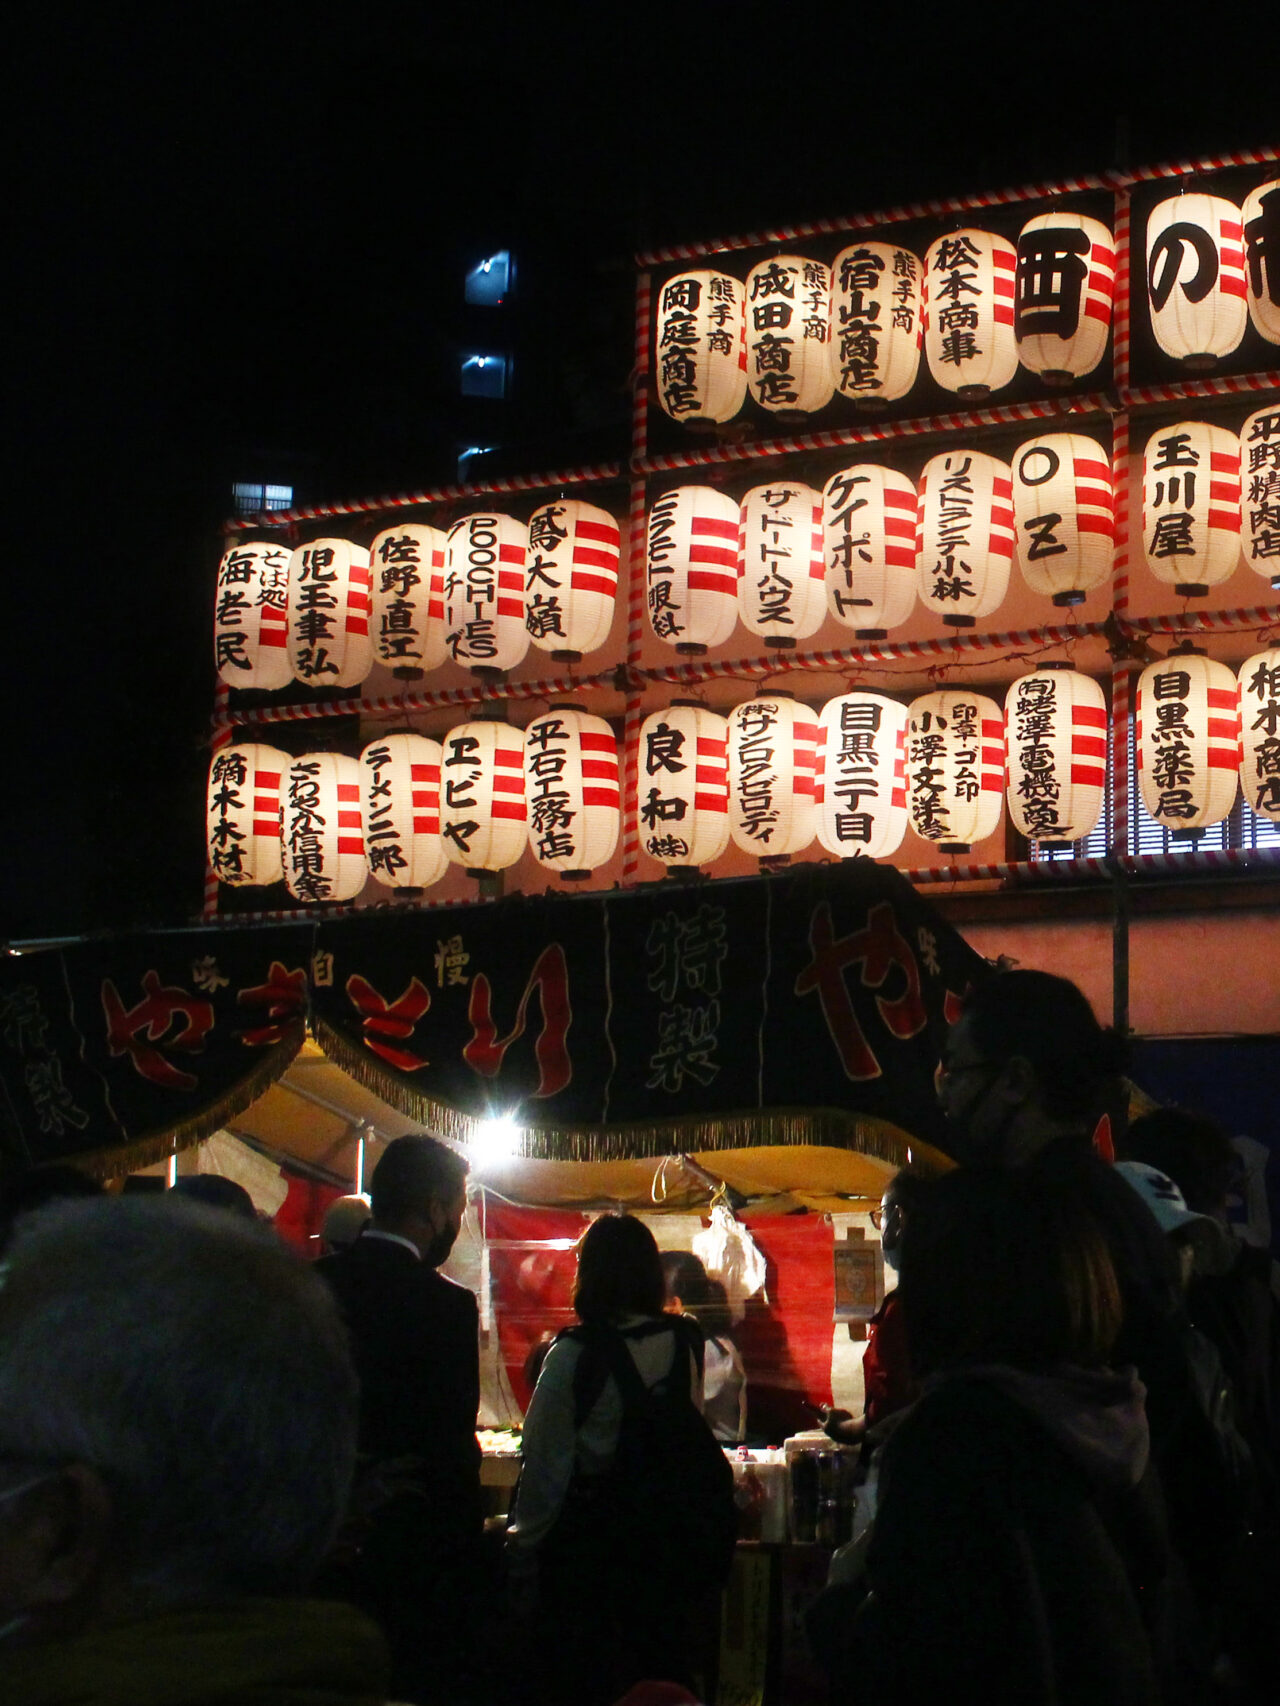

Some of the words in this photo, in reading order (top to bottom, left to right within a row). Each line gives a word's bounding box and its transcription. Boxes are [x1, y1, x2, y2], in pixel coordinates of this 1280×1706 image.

[659, 279, 702, 416] 岡庭商店
[706, 277, 737, 355] 熊手商
[750, 263, 800, 404] 成田商店
[801, 262, 828, 344] 熊手商
[838, 248, 885, 391] 宿山商店
[891, 250, 917, 334] 熊手商
[932, 237, 984, 367] 松本商事
[827, 475, 873, 617] ケイポート
[931, 457, 977, 602] リストランテ小林
[1149, 434, 1200, 559] 玉川屋
[216, 550, 259, 671] 海老民
[379, 535, 423, 660] 佐野直江
[465, 517, 499, 659] POOCHIES
[527, 720, 577, 860] 平石工務店
[910, 711, 958, 839] 小澤文洋堂
[1151, 670, 1200, 819] 目黒薬局
[366, 746, 408, 877] ラーメン二郎
